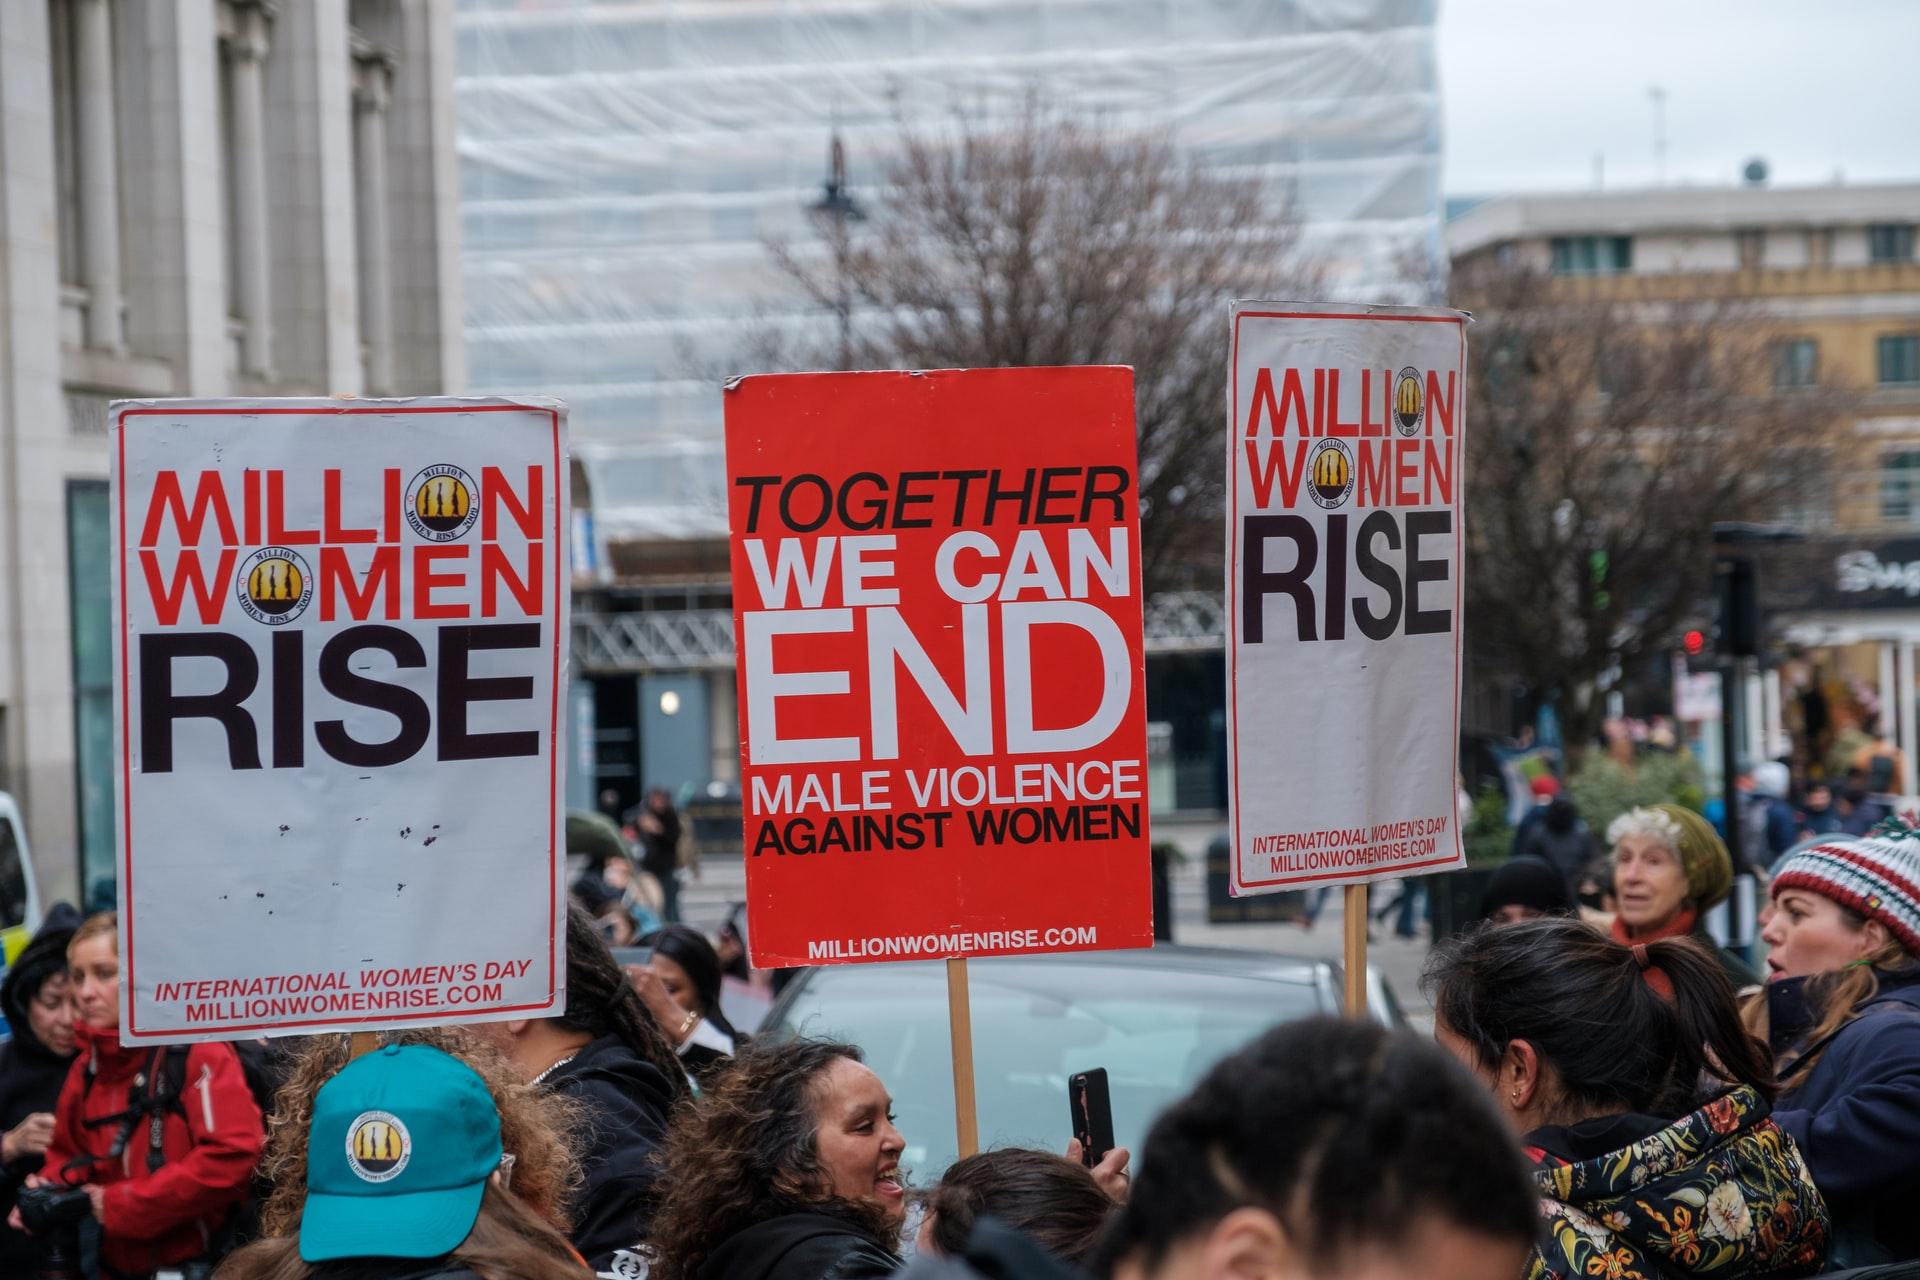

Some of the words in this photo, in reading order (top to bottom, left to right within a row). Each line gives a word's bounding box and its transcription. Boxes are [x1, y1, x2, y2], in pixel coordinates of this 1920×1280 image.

[423, 467, 464, 479] MILLION
[736, 465, 1130, 533] TOGETHER
[408, 510, 432, 537] WOMEN
[436, 530, 456, 540] RISE
[255, 549, 297, 561] MILLION
[743, 534, 900, 610] WE
[935, 527, 1130, 604] CAN
[1243, 510, 1451, 644] RISE
[139, 622, 541, 773] RISE
[743, 600, 1131, 766] END
[751, 770, 892, 815] MALE
[905, 759, 1141, 808] VIOLENCE
[753, 811, 952, 857] AGAINST
[967, 803, 1141, 846] WOMEN
[1253, 829, 1368, 854] INTERNATIONAL
[1371, 822, 1424, 842] WOMEN'S
[1427, 816, 1446, 834] DAY
[1271, 838, 1436, 873] MILLIONWOMENRISE.COM
[808, 926, 1097, 959] MILLIONWOMENRISE.COM
[155, 971, 350, 1001] INTERNATIONAL
[360, 963, 477, 988] WOMEN'S
[483, 959, 533, 979] DAY
[186, 984, 502, 1022] MILLIONWOMENRISE.COM
